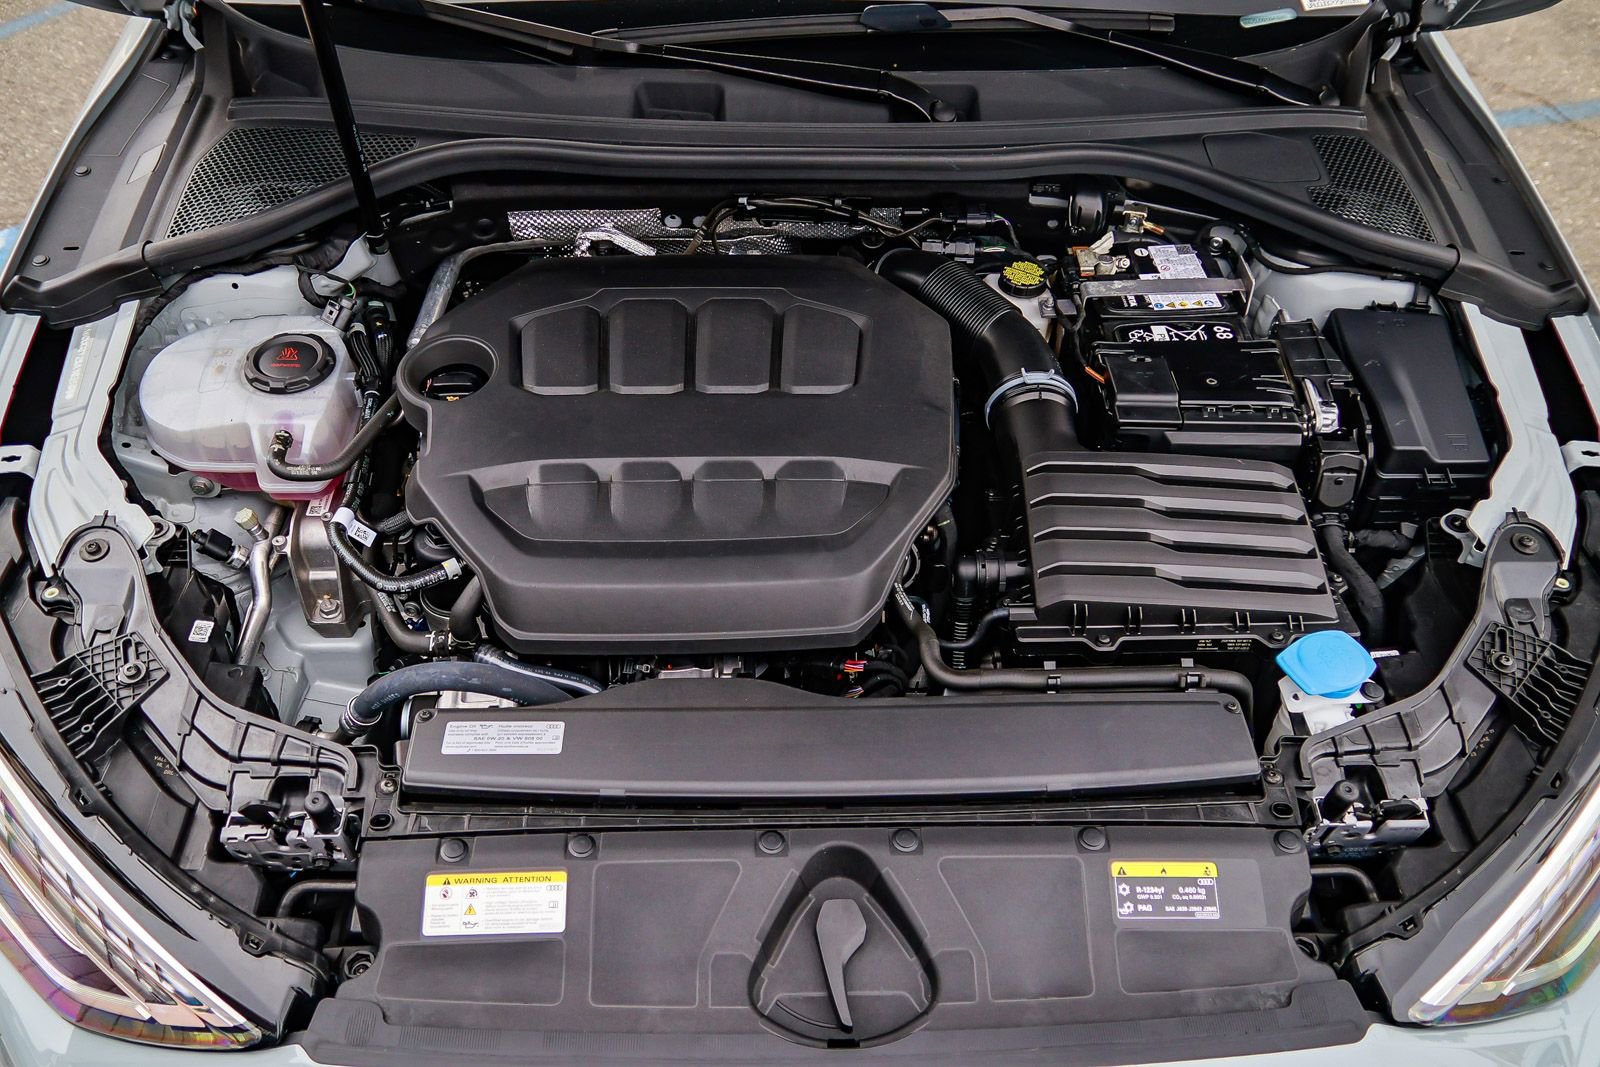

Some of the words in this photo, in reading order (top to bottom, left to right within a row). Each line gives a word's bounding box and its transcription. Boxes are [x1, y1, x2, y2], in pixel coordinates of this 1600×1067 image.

[1213, 326, 1234, 340] 68
[454, 877, 498, 885] WARNING
[502, 875, 552, 883] ATTENTION
[1136, 886, 1165, 895] R-1234yf
[1198, 886, 1206, 895] kg
